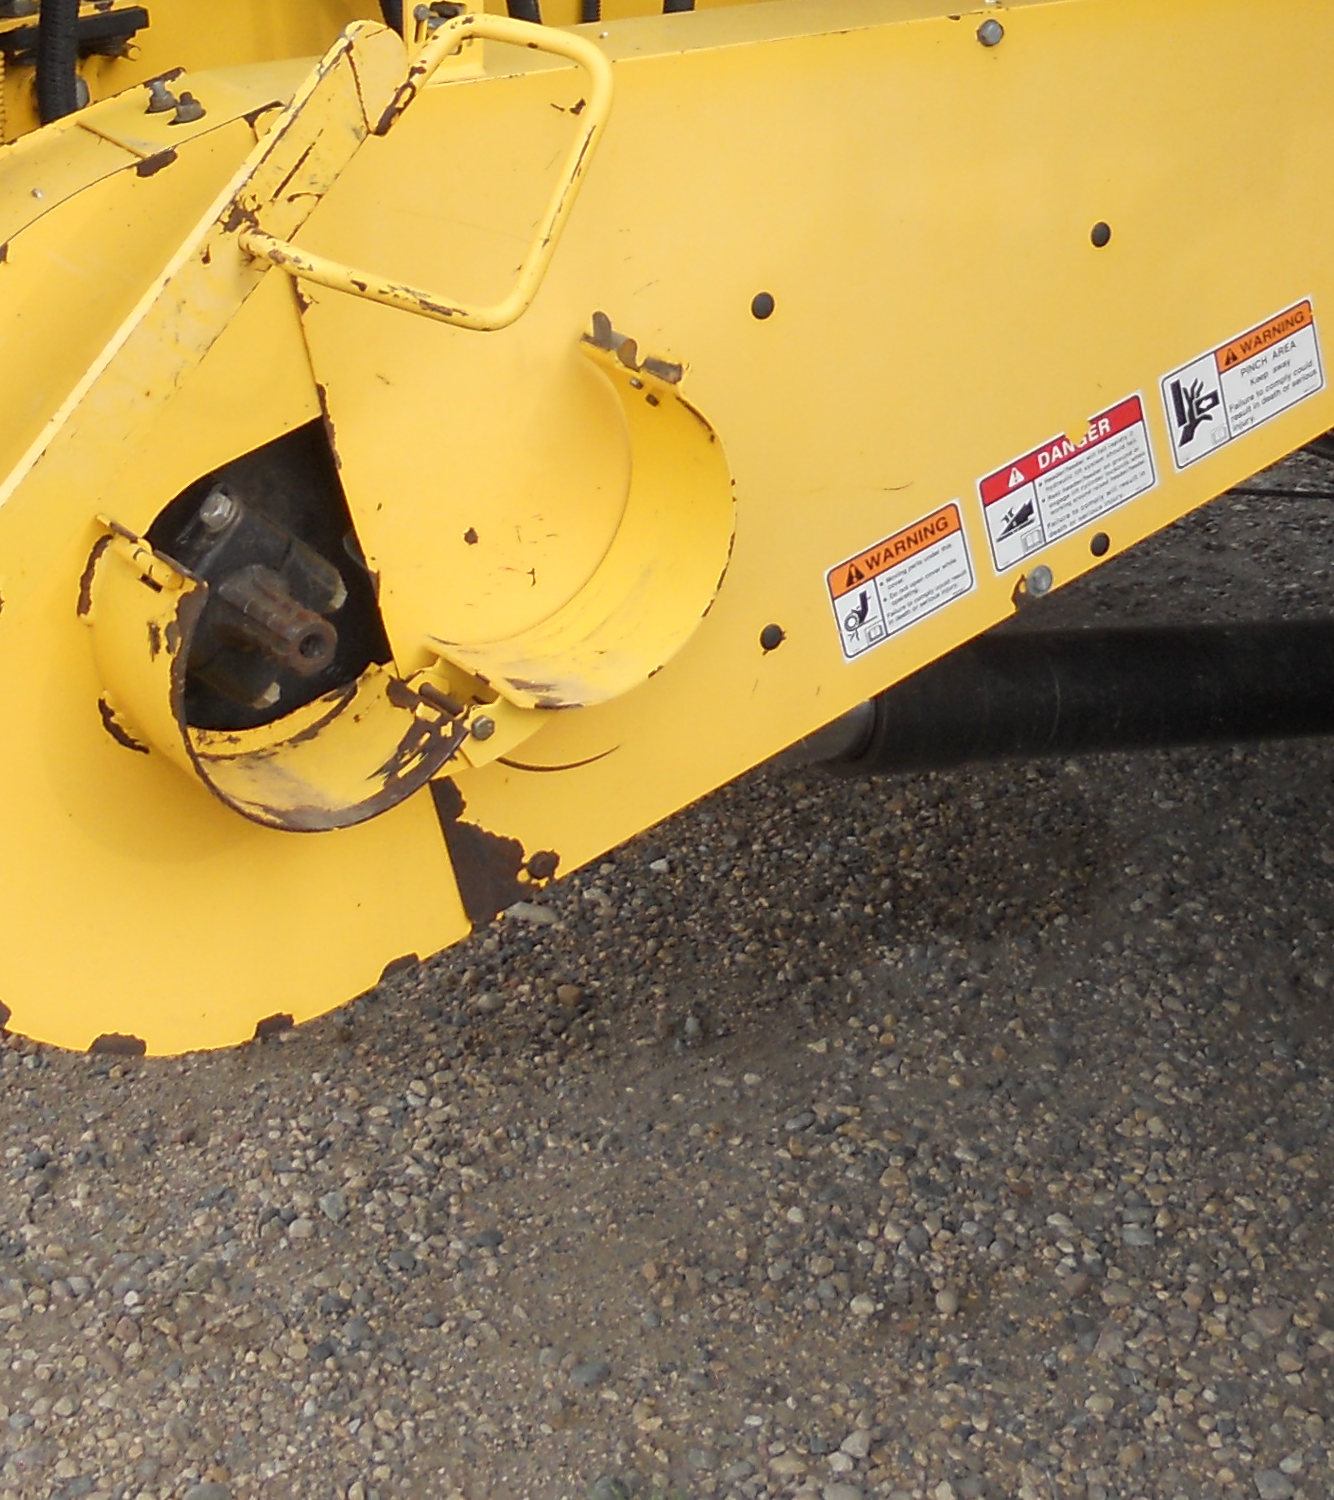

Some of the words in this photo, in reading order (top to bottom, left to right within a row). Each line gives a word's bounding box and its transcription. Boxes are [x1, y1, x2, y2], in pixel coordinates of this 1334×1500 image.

[1240, 311, 1304, 355] WARNING
[1241, 356, 1268, 377] PINCH
[1272, 340, 1296, 359] AREA
[865, 516, 949, 571] WARNING
